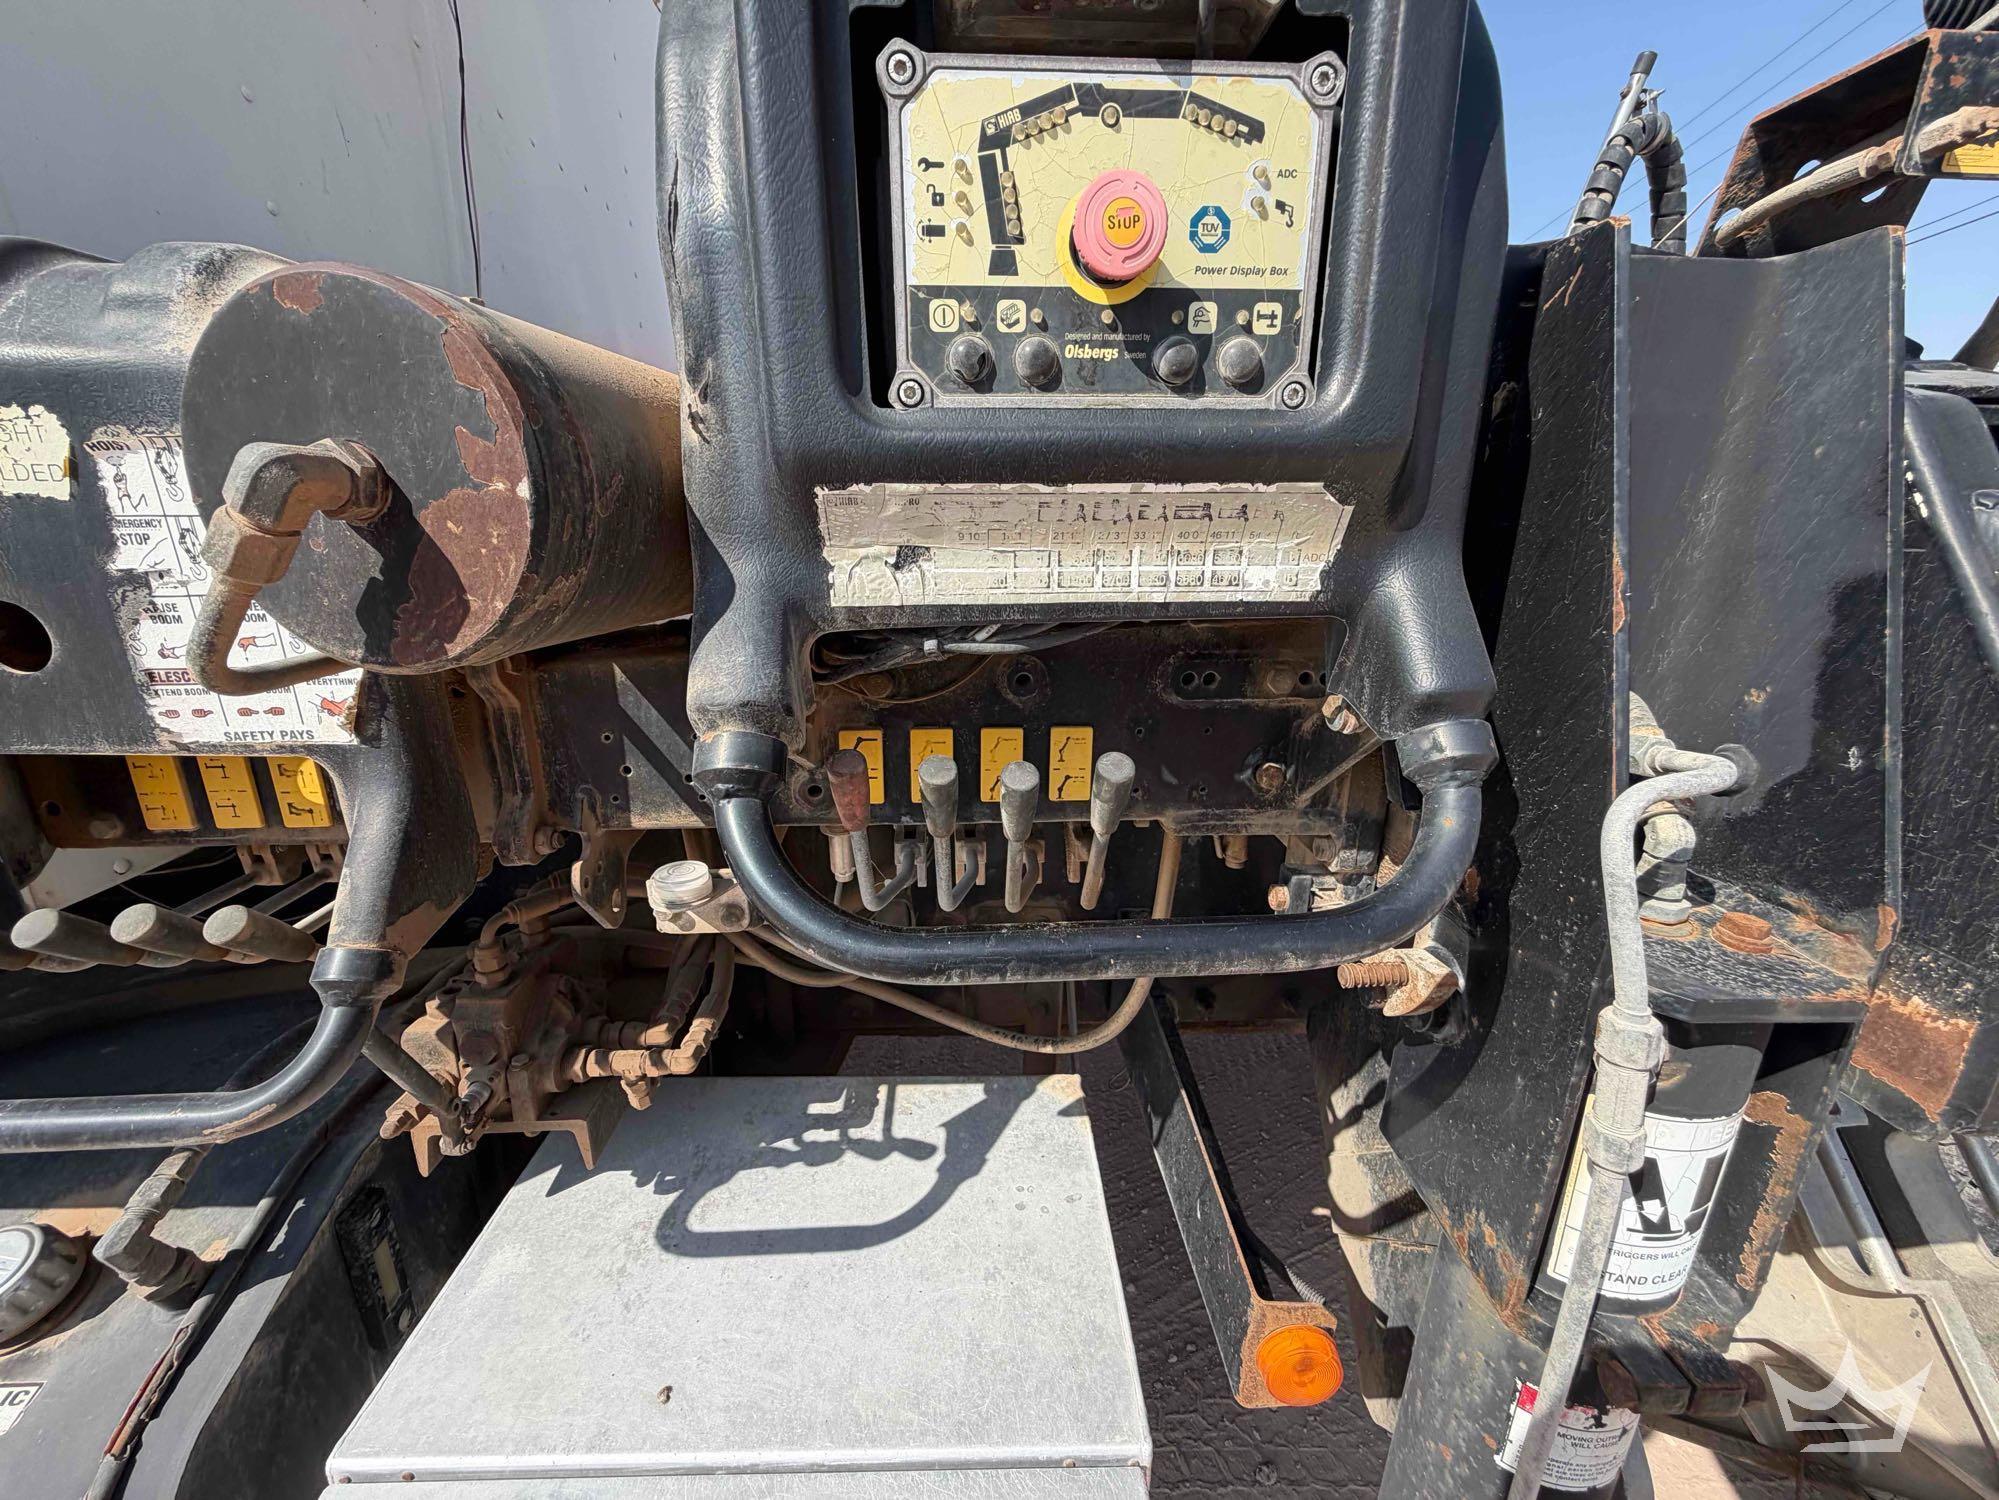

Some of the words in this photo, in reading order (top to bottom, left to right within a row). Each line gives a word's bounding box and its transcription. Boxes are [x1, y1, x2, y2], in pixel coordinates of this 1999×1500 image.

[997, 108, 1022, 129] HIAB
[1277, 169, 1298, 179] ADC
[1194, 265, 1228, 276] Power
[1229, 265, 1267, 278] Display
[1269, 266, 1289, 276] Box
[1064, 332, 1091, 342] Designed
[1091, 333, 1103, 341] and
[1103, 333, 1143, 341] manufactured
[1143, 333, 1151, 342] by
[1064, 344, 1119, 362] Olsbergs
[1124, 351, 1147, 359] Sweden
[120, 532, 151, 546] STOP
[149, 614, 184, 625] BOOM
[244, 612, 268, 623] OOM
[223, 730, 275, 742] SAFETY
[279, 728, 315, 741] PAYS
[1661, 1250, 1680, 1261] WILL
[1557, 1431, 1594, 1444] MOVING
[1571, 1441, 1591, 1450] WILL
